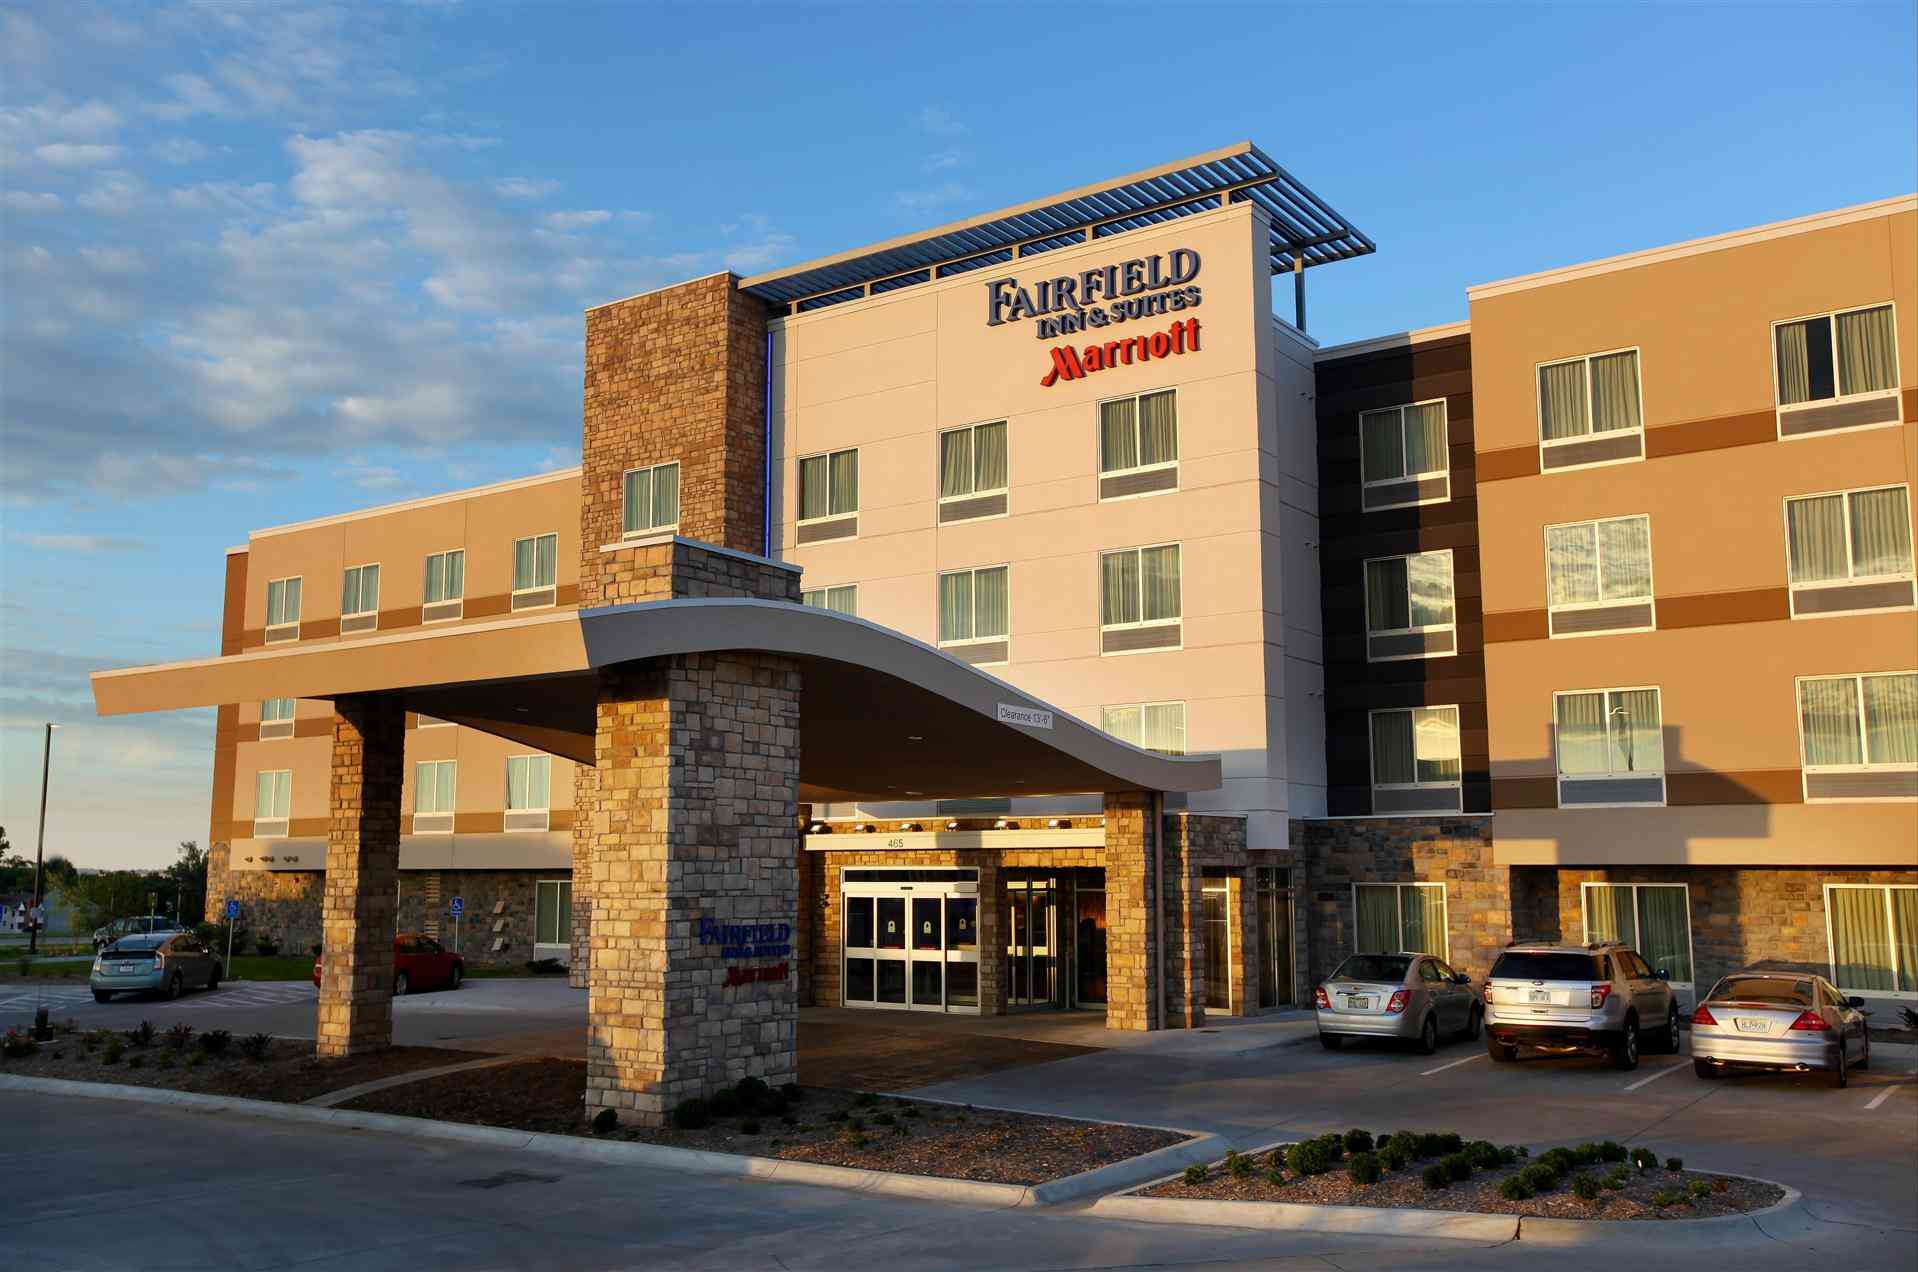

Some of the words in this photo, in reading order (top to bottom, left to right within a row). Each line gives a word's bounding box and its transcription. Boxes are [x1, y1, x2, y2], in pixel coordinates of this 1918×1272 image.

[986, 248, 1202, 326] FAIRFIELD
[1040, 317, 1202, 387] Marriott
[1000, 707, 1032, 722] Clearance
[888, 838, 904, 848] 465
